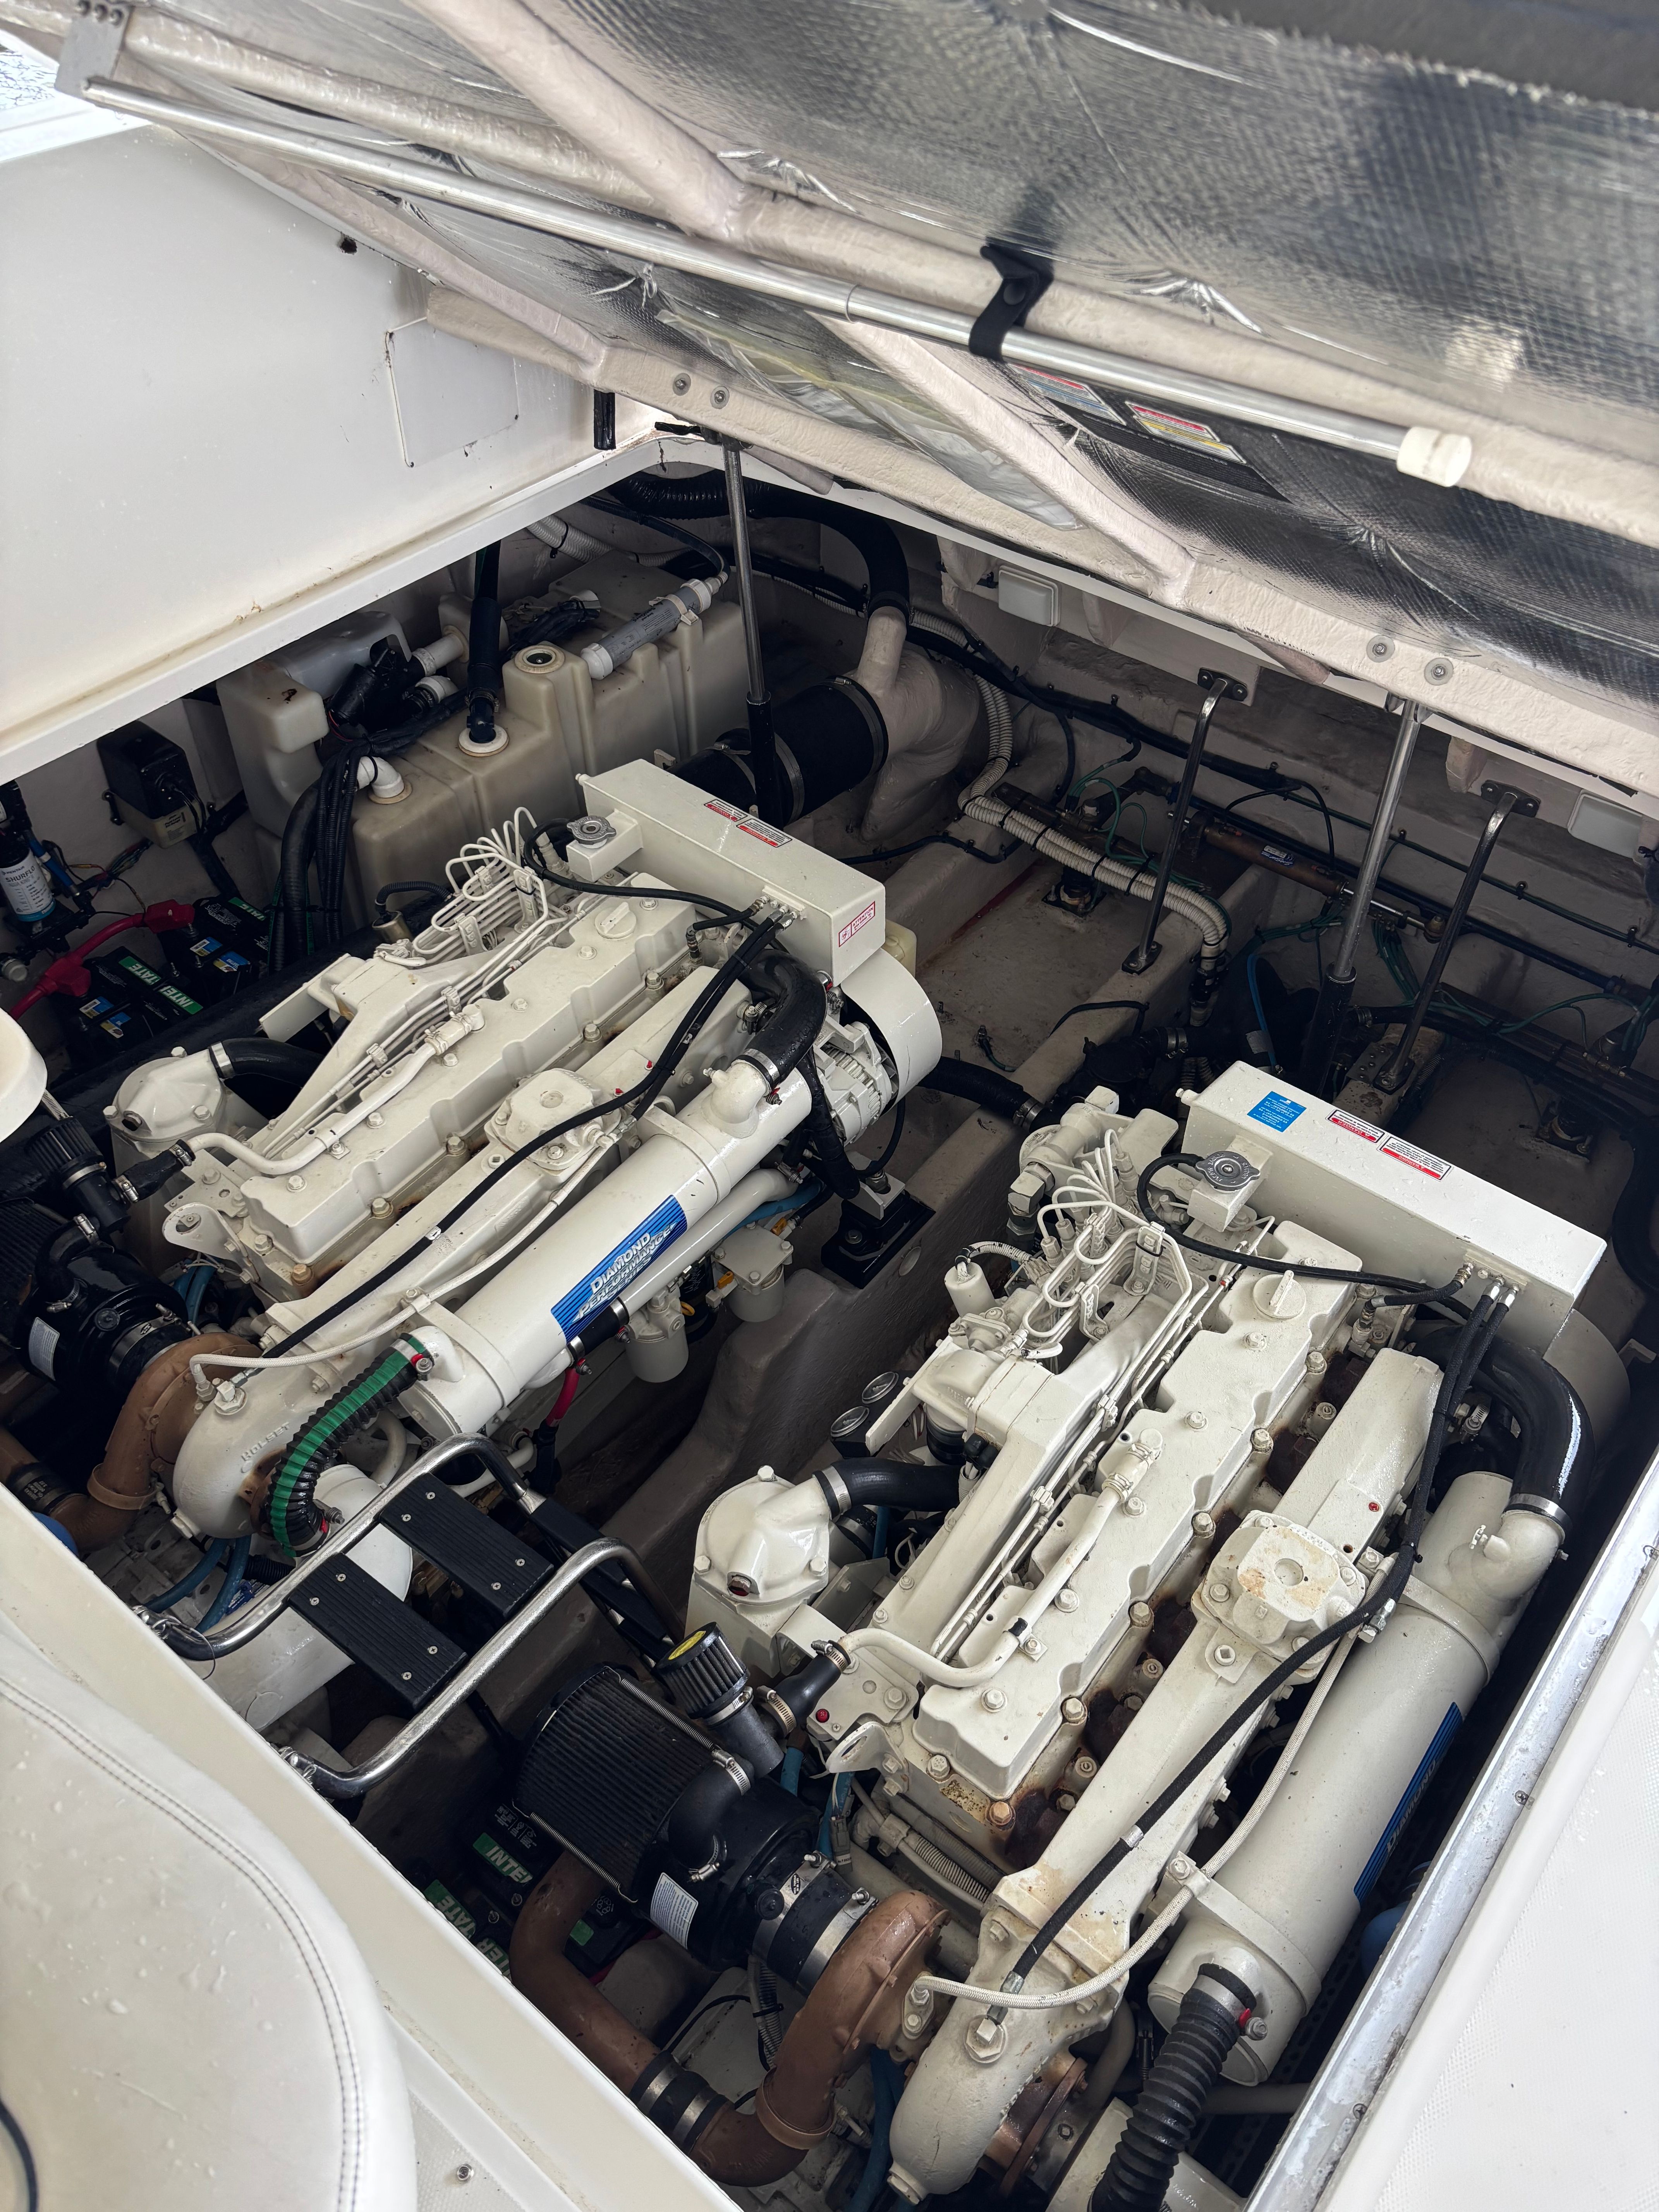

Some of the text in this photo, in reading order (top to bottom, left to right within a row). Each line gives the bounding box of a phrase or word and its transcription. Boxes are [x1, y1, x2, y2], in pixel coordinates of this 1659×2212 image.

[5, 866, 36, 883] SHURFLO
[1338, 1120, 1363, 1133] DANGER
[579, 1224, 672, 1319] PERFORMANCE
[590, 1231, 651, 1295] DIAMOND
[608, 1255, 653, 1298] SERIES
[240, 1420, 292, 1463] HOLSET
[436, 1895, 476, 1940] TATE
